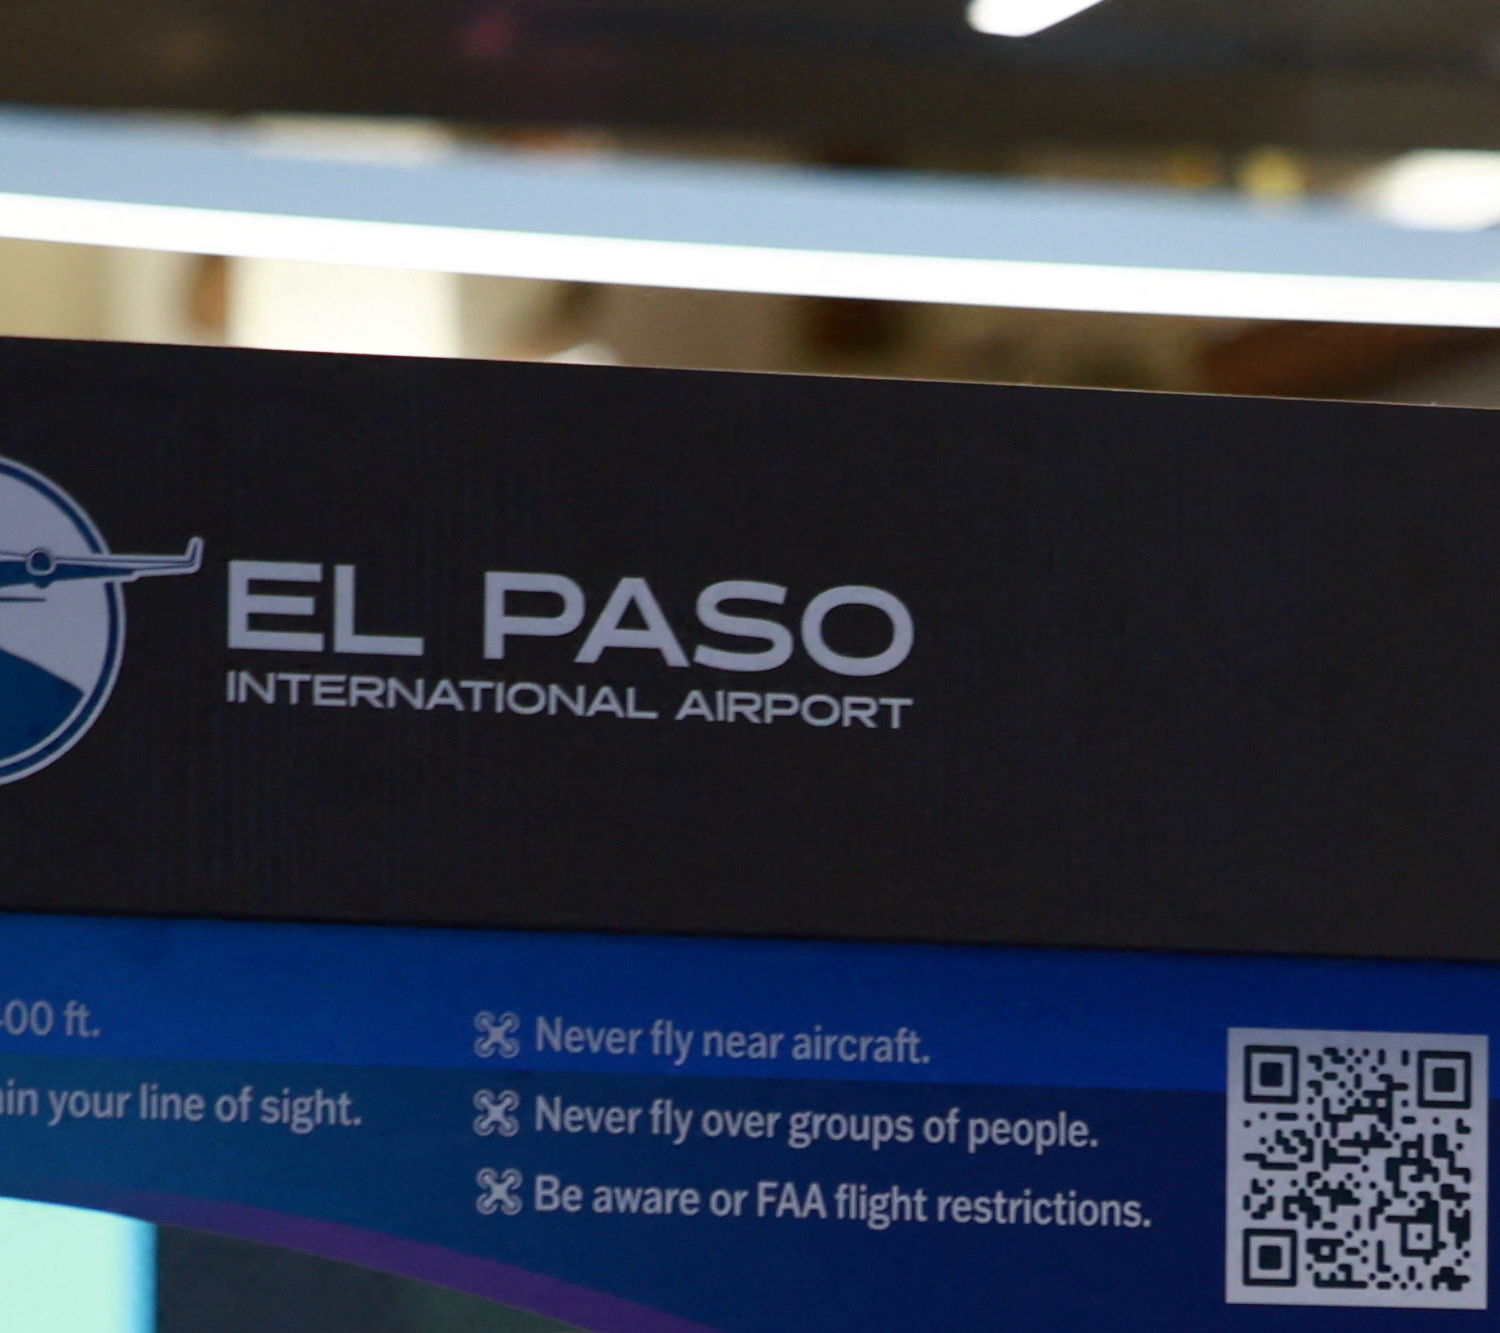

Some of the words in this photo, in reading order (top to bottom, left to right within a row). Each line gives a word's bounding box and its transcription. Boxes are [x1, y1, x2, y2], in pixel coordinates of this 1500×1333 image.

[227, 559, 424, 656] EL
[483, 570, 915, 677] PASO
[226, 670, 659, 720] INTERNATIONAL
[674, 689, 913, 729] AIRPORT
[63, 998, 101, 1038] ft.
[535, 1015, 643, 1056] Never
[650, 1018, 694, 1067] fly
[702, 1028, 784, 1060] near
[791, 1024, 932, 1065] aircraft.
[47, 1088, 132, 1127] your
[139, 1082, 205, 1123] line
[214, 1085, 253, 1124] of
[260, 1087, 362, 1135] sight.
[534, 1095, 642, 1135] Never
[649, 1098, 693, 1146] fly
[701, 1109, 781, 1139] over
[787, 1110, 914, 1151] groups
[922, 1107, 960, 1145] of
[967, 1110, 1099, 1156] people.
[534, 1173, 584, 1212] Be
[591, 1183, 700, 1217] aware
[709, 1188, 749, 1218] or
[756, 1180, 827, 1219] FAA
[834, 1183, 928, 1231] flight
[936, 1187, 1153, 1229] restrictions.
